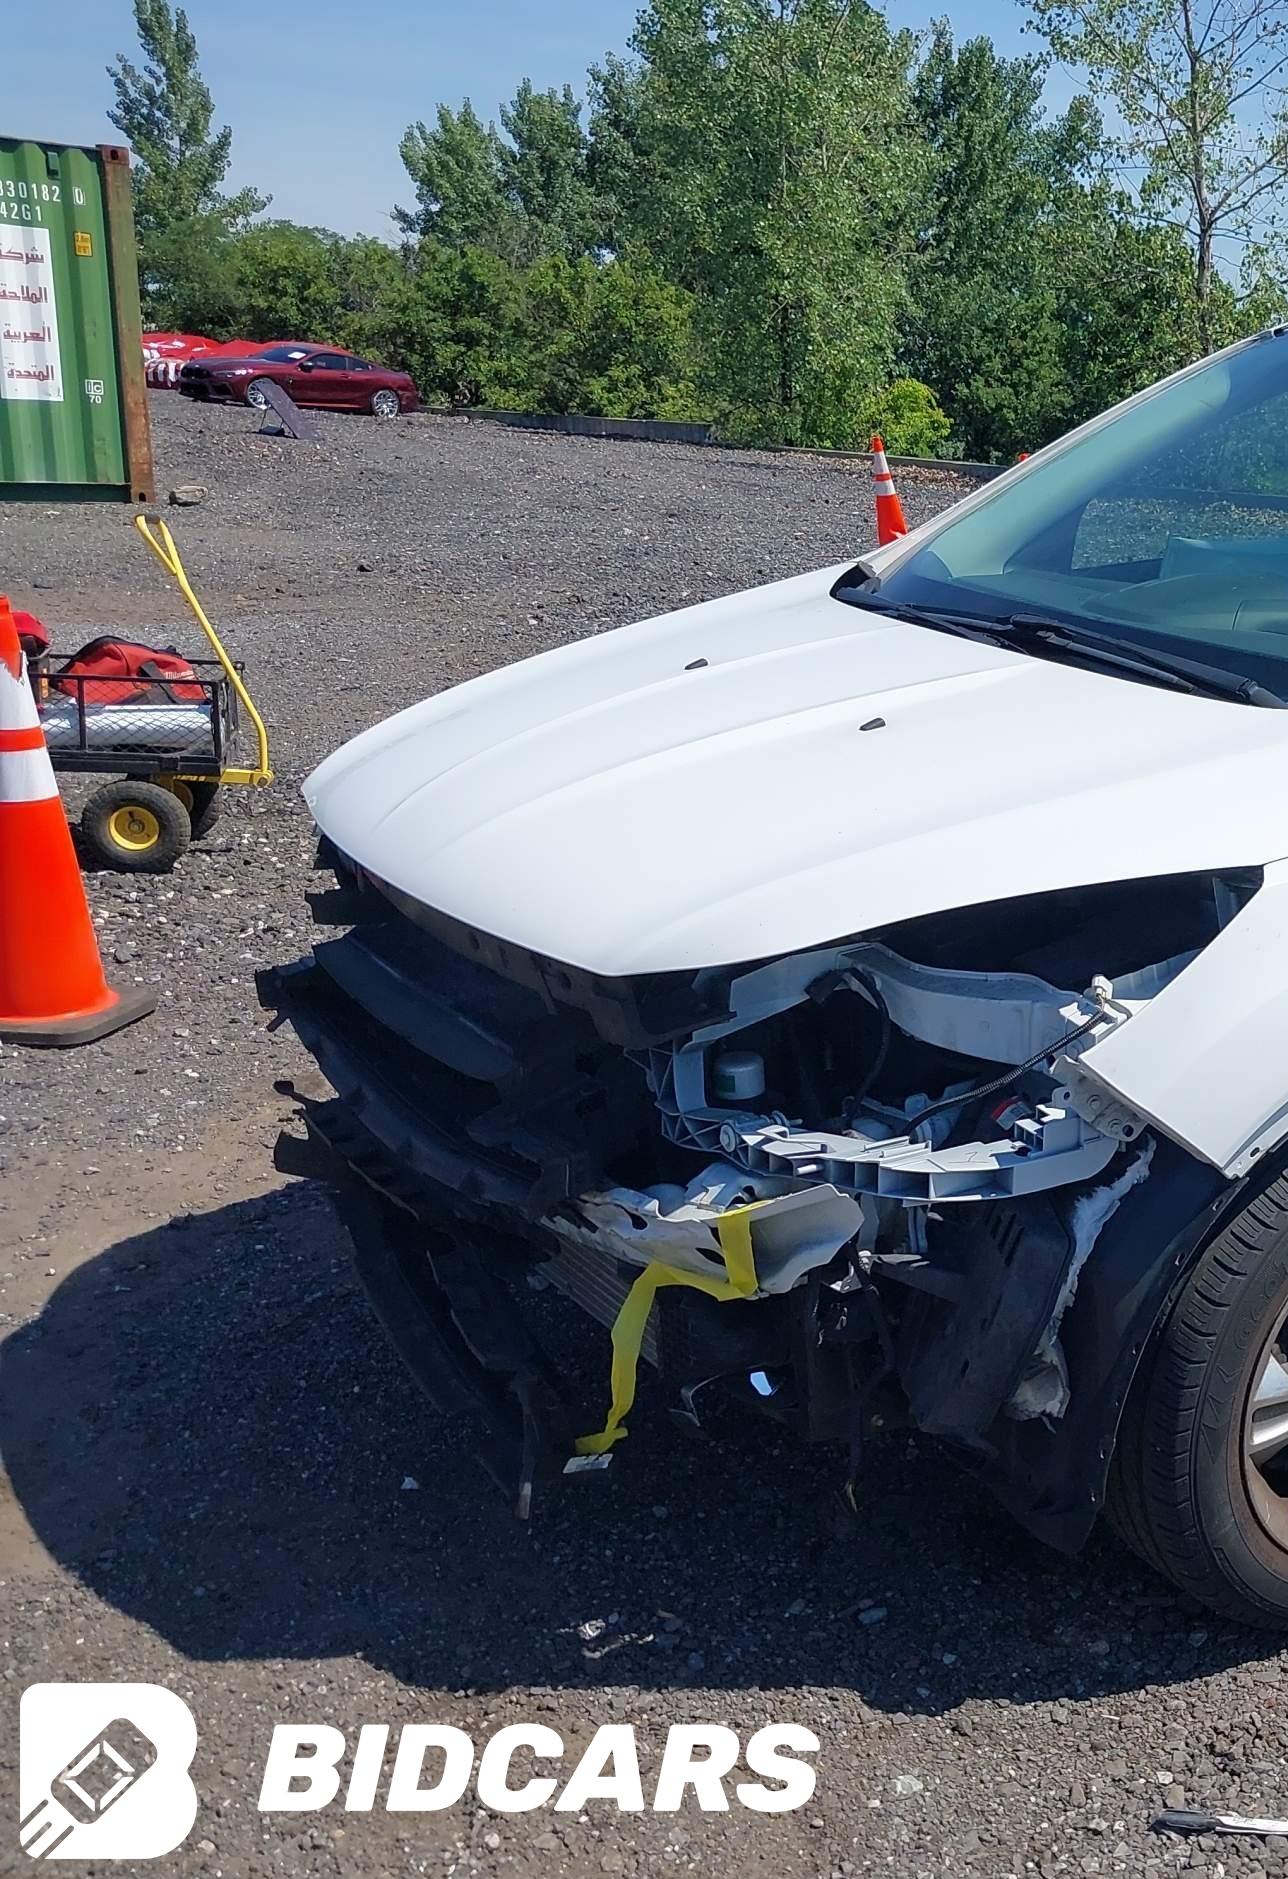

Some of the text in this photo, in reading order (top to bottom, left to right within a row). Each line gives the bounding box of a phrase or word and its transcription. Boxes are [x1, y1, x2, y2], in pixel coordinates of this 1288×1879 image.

[0, 201, 42, 222] 42G1
[0, 245, 44, 264] شرك
[89, 395, 102, 404] 70
